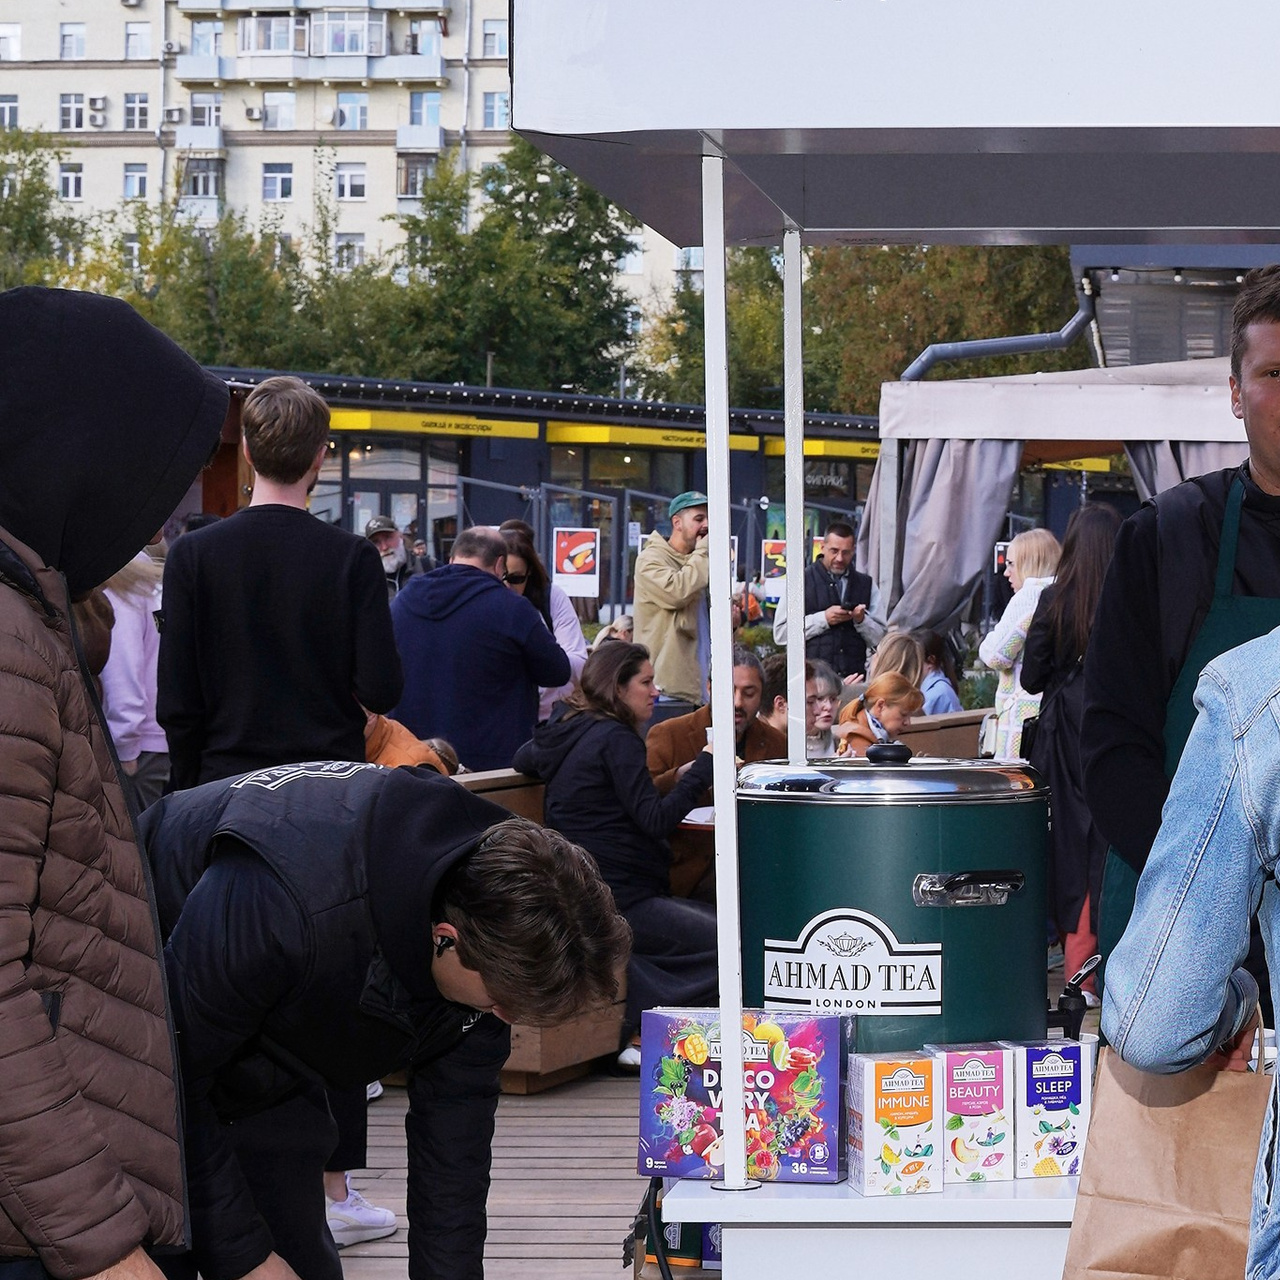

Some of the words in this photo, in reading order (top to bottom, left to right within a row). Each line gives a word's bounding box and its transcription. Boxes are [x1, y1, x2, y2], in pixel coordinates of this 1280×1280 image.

[768, 960, 872, 991] AHMAD
[878, 964, 937, 991] TEA
[815, 998, 876, 1009] LONDON
[749, 1046, 767, 1056] TEA
[703, 1069, 775, 1089] DCO
[883, 1080, 910, 1088] AHMAD
[949, 1085, 1000, 1099] BEAUTY
[1035, 1080, 1073, 1094] SLEEP
[708, 1090, 770, 1110] VRY
[878, 1095, 930, 1109] IMMUNE
[645, 1157, 654, 1169] 9
[791, 1162, 807, 1174] 36
